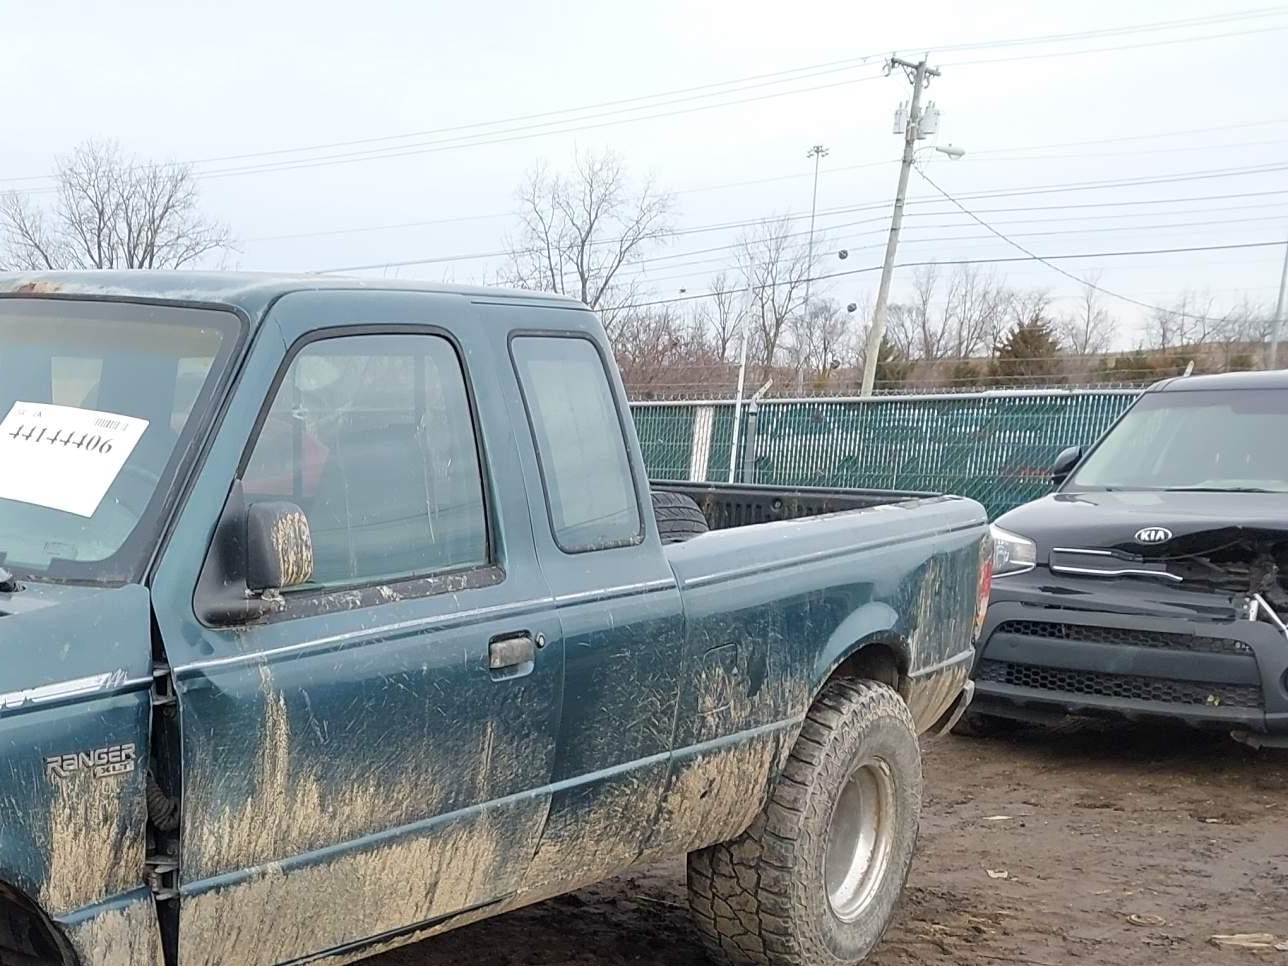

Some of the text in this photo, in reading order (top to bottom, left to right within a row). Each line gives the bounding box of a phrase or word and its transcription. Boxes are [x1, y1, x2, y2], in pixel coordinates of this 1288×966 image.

[9, 425, 112, 453] 44144406
[1139, 529, 1166, 542] KIA
[44, 743, 136, 778] RANGER
[99, 761, 130, 776] XLT
